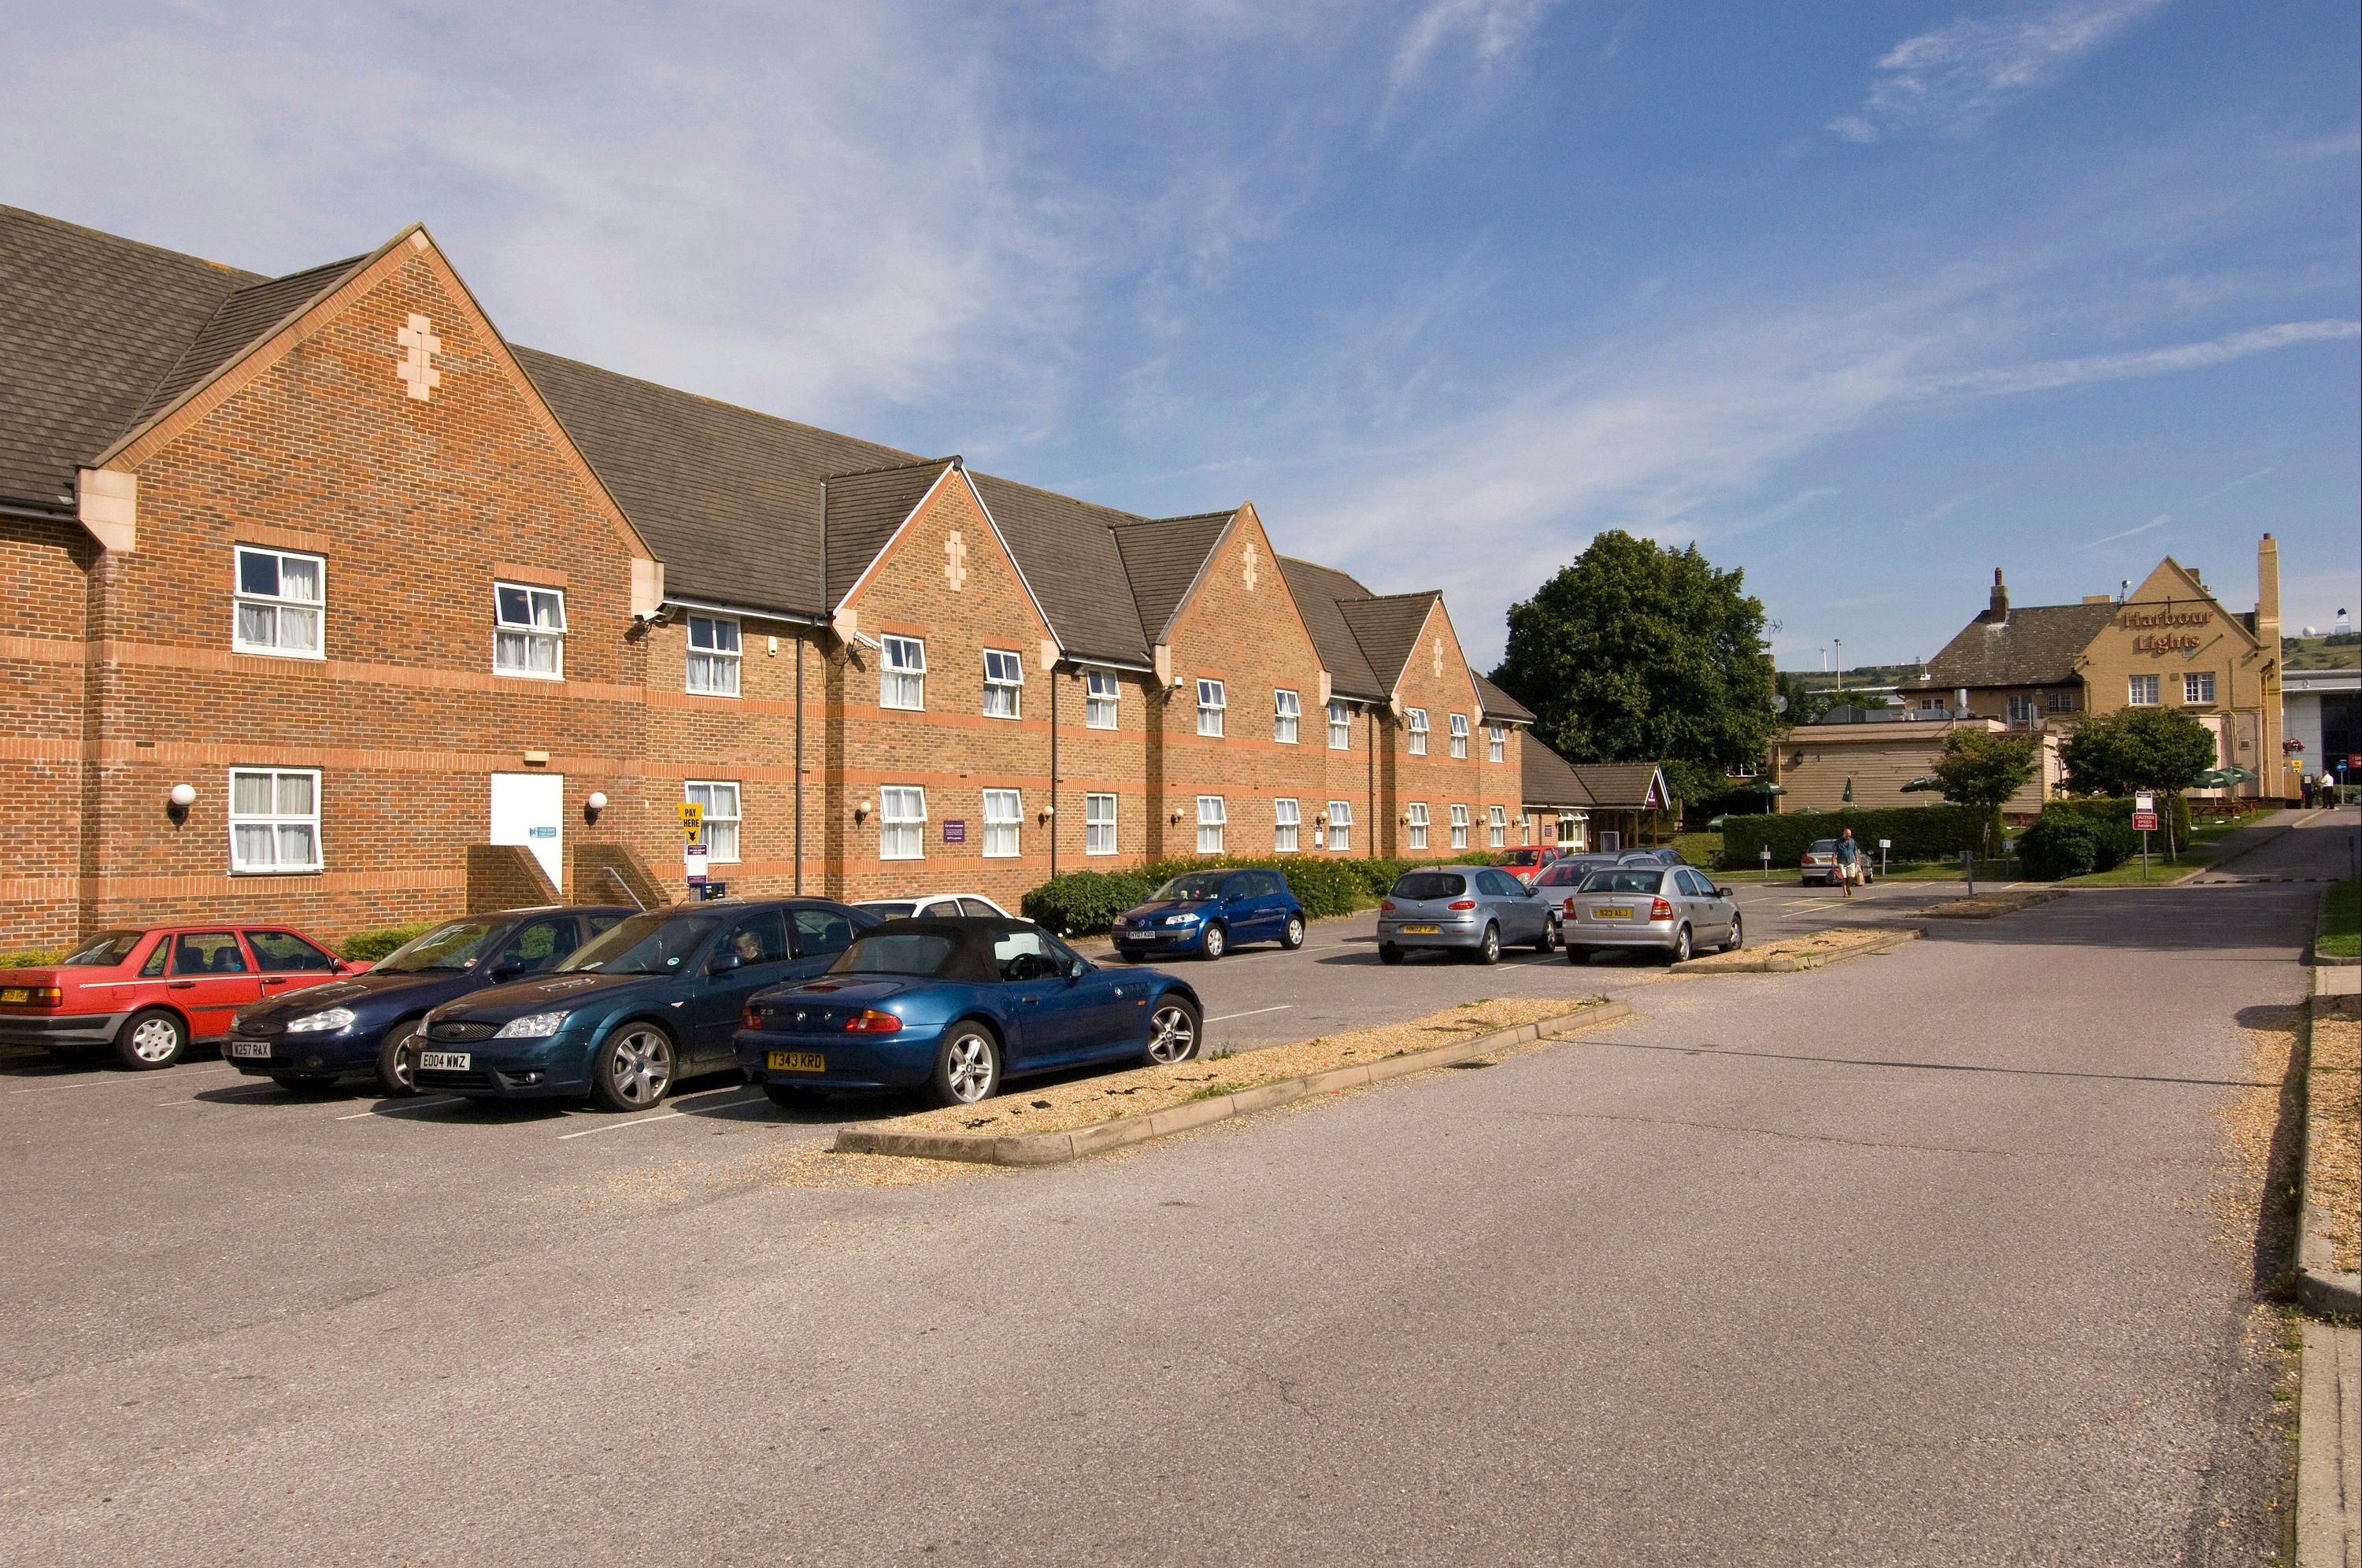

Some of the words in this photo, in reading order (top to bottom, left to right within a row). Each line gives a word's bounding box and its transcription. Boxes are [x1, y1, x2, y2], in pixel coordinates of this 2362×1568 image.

[2124, 609, 2213, 627] Harbour
[2138, 632, 2200, 654] Lights
[684, 808, 696, 817] PAY
[235, 1044, 251, 1055] W257
[254, 1045, 268, 1055] RAX
[446, 1055, 465, 1067] WWZ
[772, 1053, 798, 1067] T343
[801, 1055, 821, 1067] KRD
